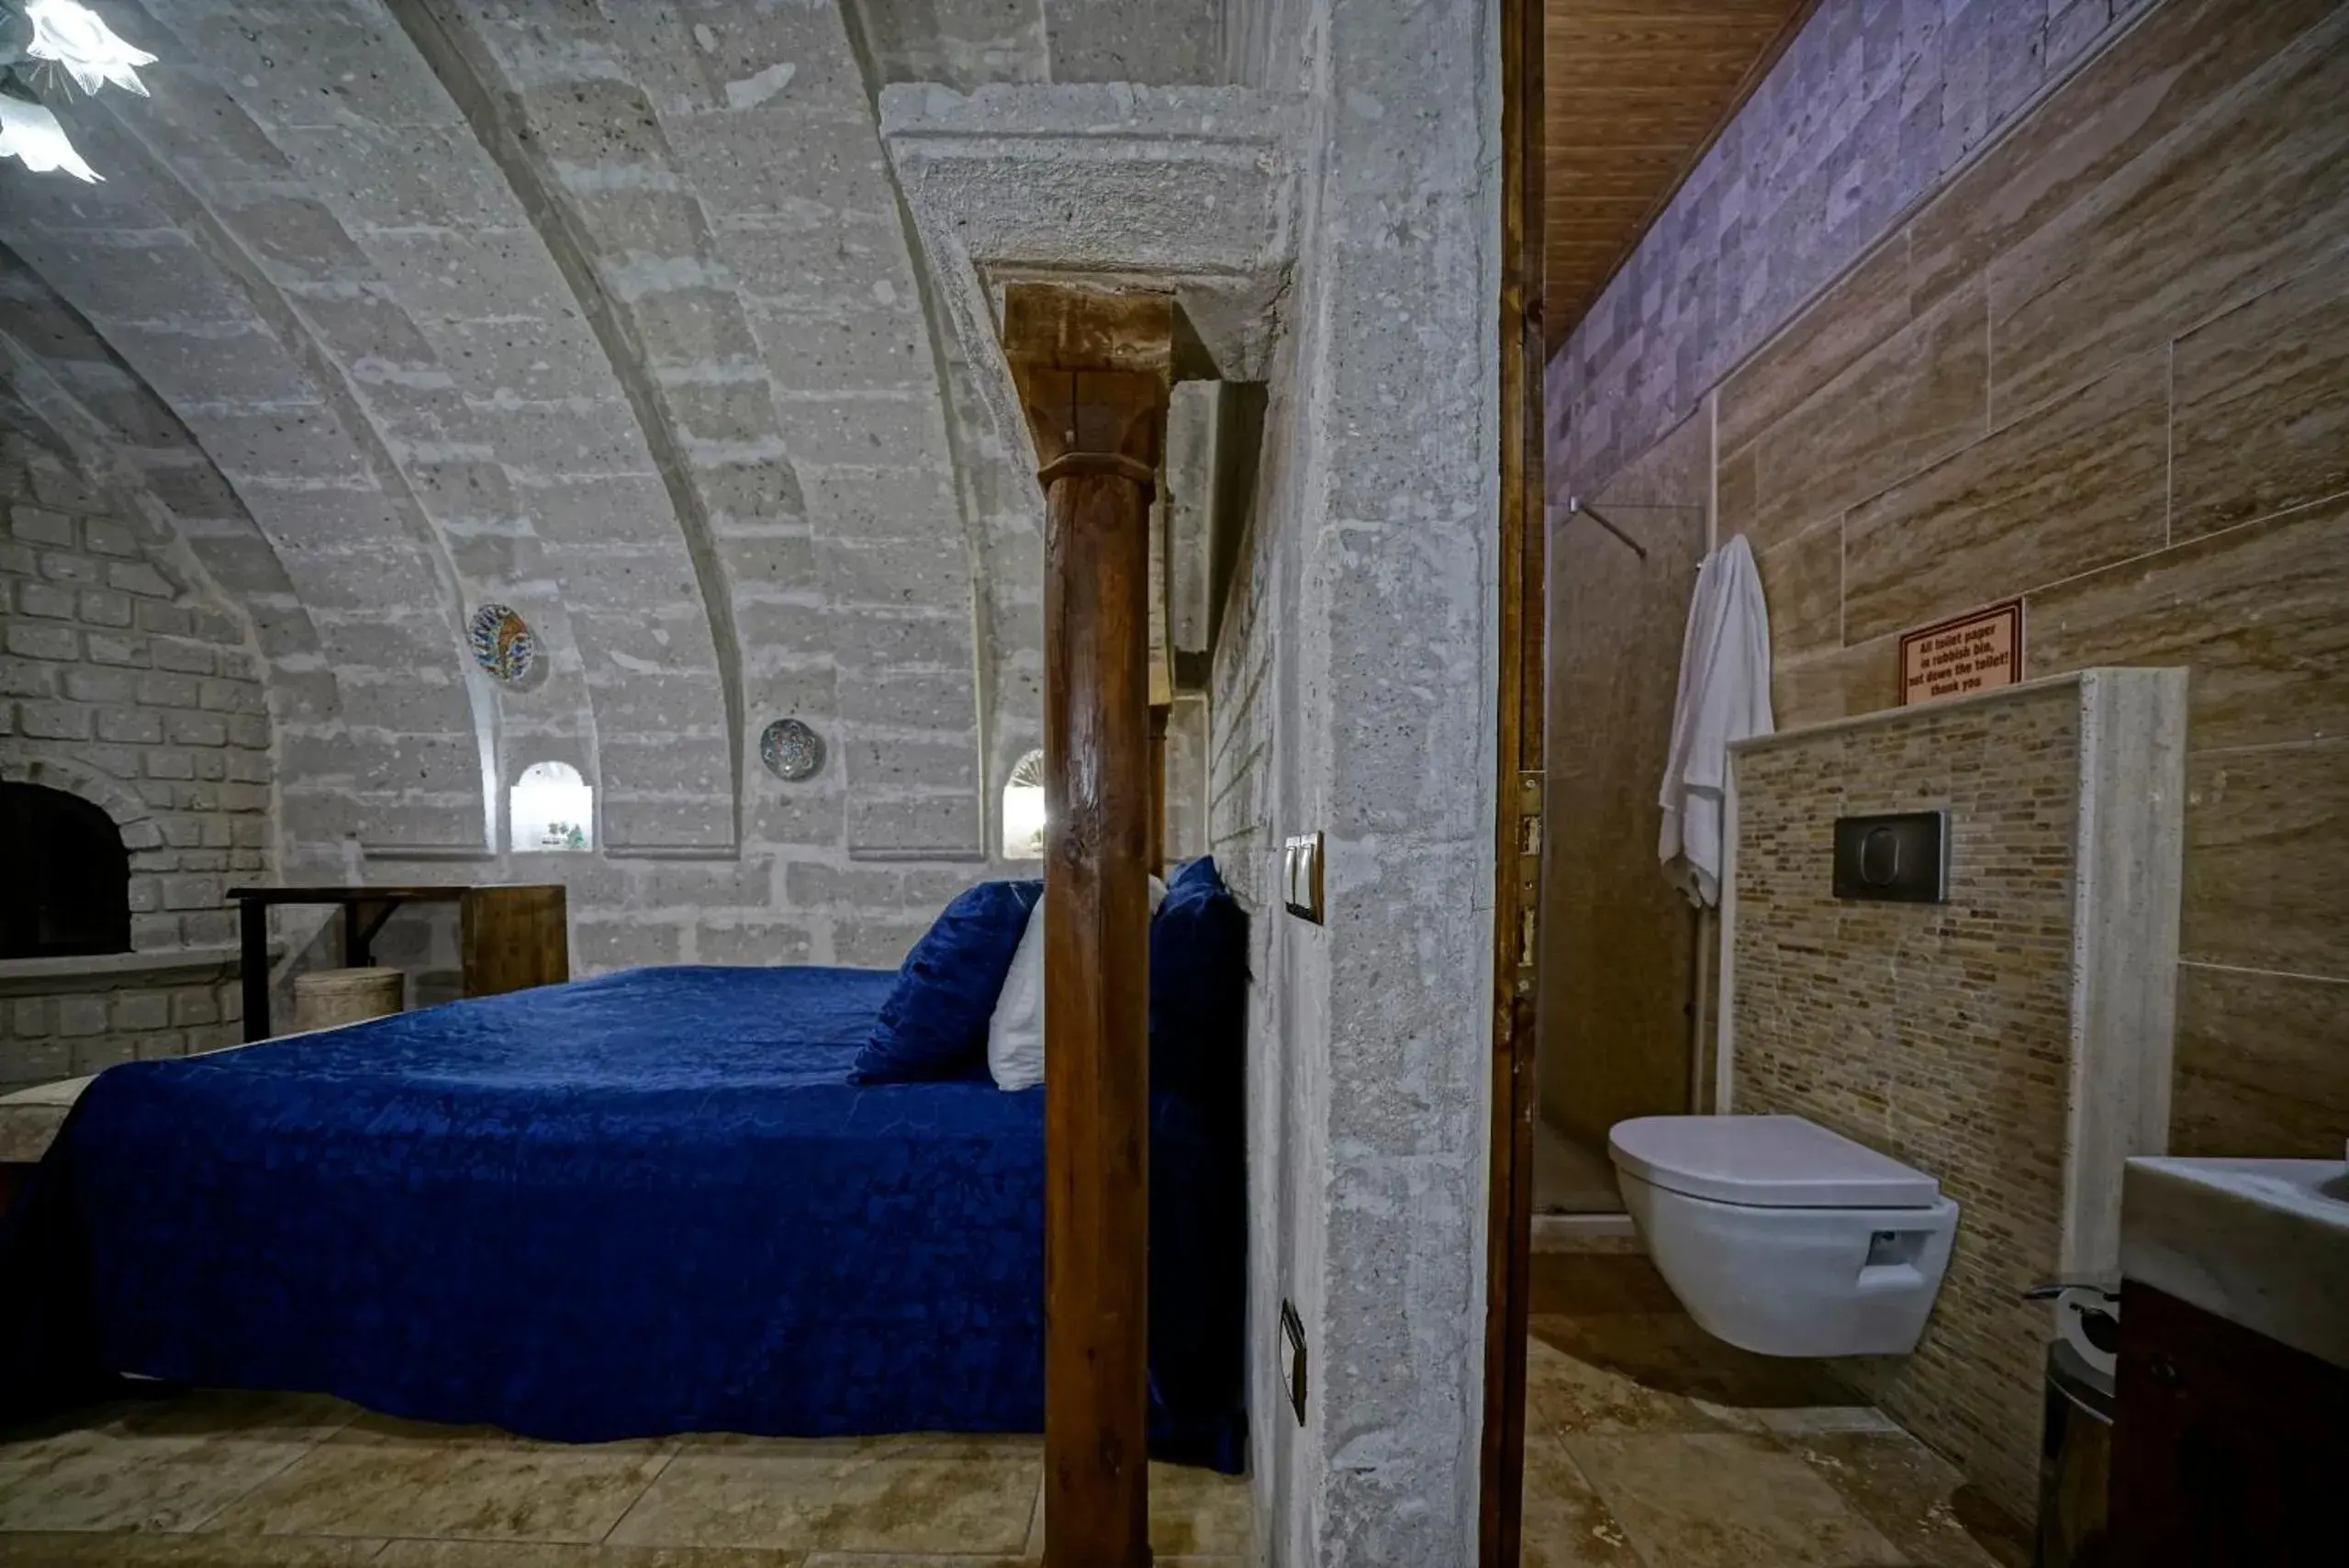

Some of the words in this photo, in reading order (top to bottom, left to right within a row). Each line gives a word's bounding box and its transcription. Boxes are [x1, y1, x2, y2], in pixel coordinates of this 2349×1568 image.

[1920, 641, 1932, 654] All
[1935, 633, 1962, 650] toilet
[1965, 624, 1997, 643] paper
[1909, 673, 1924, 687] not
[1927, 668, 1952, 683] down
[1955, 663, 1972, 675] the
[1975, 651, 2008, 670] toilet!
[1920, 658, 1930, 668] in
[1933, 646, 1970, 666] rubbish
[1930, 681, 1958, 696] thank
[1963, 677, 1982, 692] you
